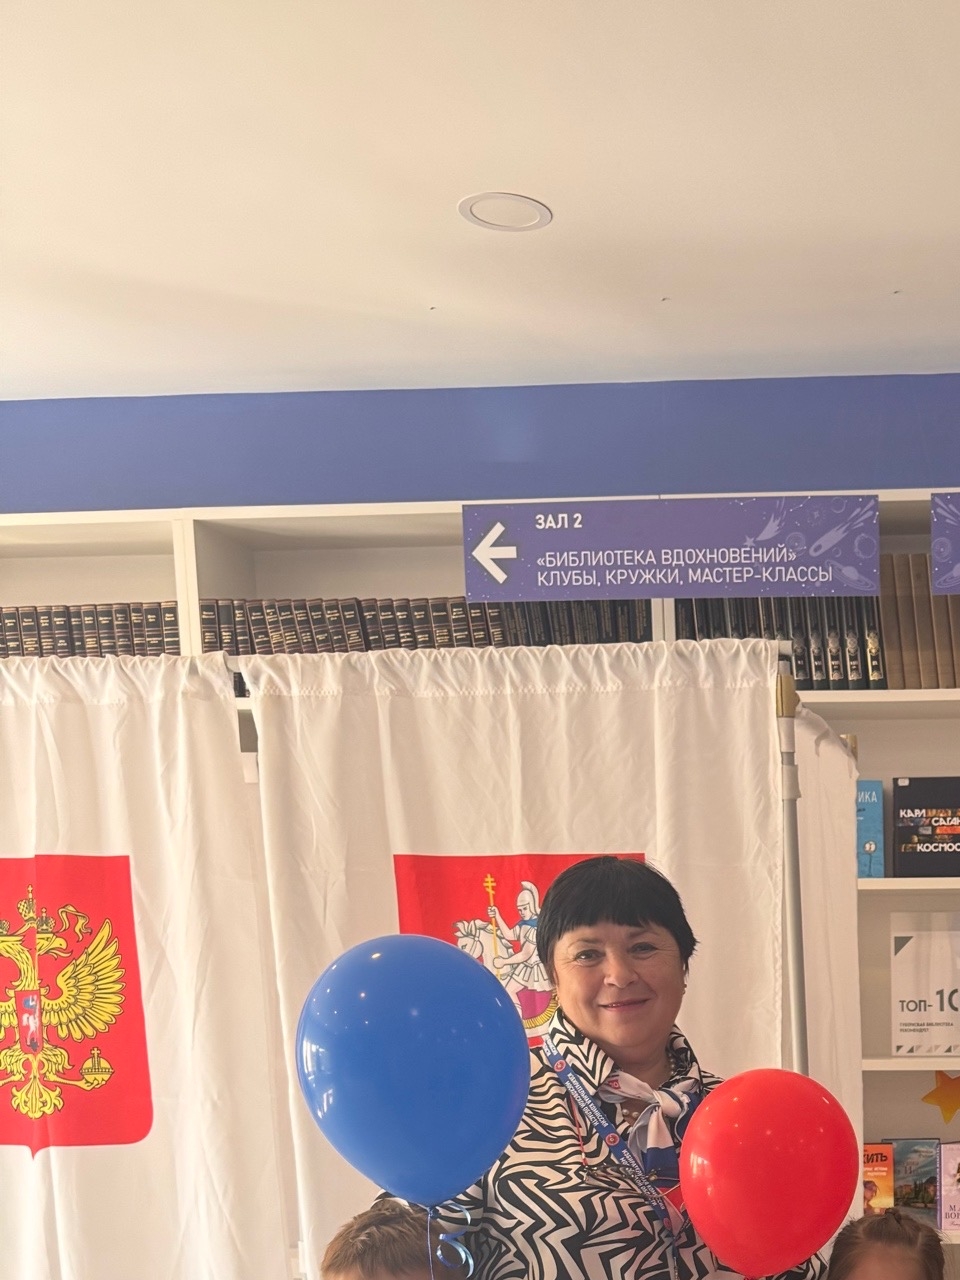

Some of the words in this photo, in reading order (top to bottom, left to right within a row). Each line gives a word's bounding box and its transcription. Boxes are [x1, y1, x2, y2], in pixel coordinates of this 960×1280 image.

[535, 514, 568, 529] ЗАЛ
[573, 513, 583, 529] 2
[536, 550, 656, 567] «БИБЛИОТЕКА
[661, 544, 797, 566] ВДОХНОВЕНИЙ»
[537, 570, 601, 587] КЛУБЫ,
[605, 568, 683, 585] КРУЖКИ,
[688, 566, 832, 583] МАСТЕР-КЛАССЫ
[858, 791, 878, 802] ИКА
[900, 809, 926, 818] КАРЛ
